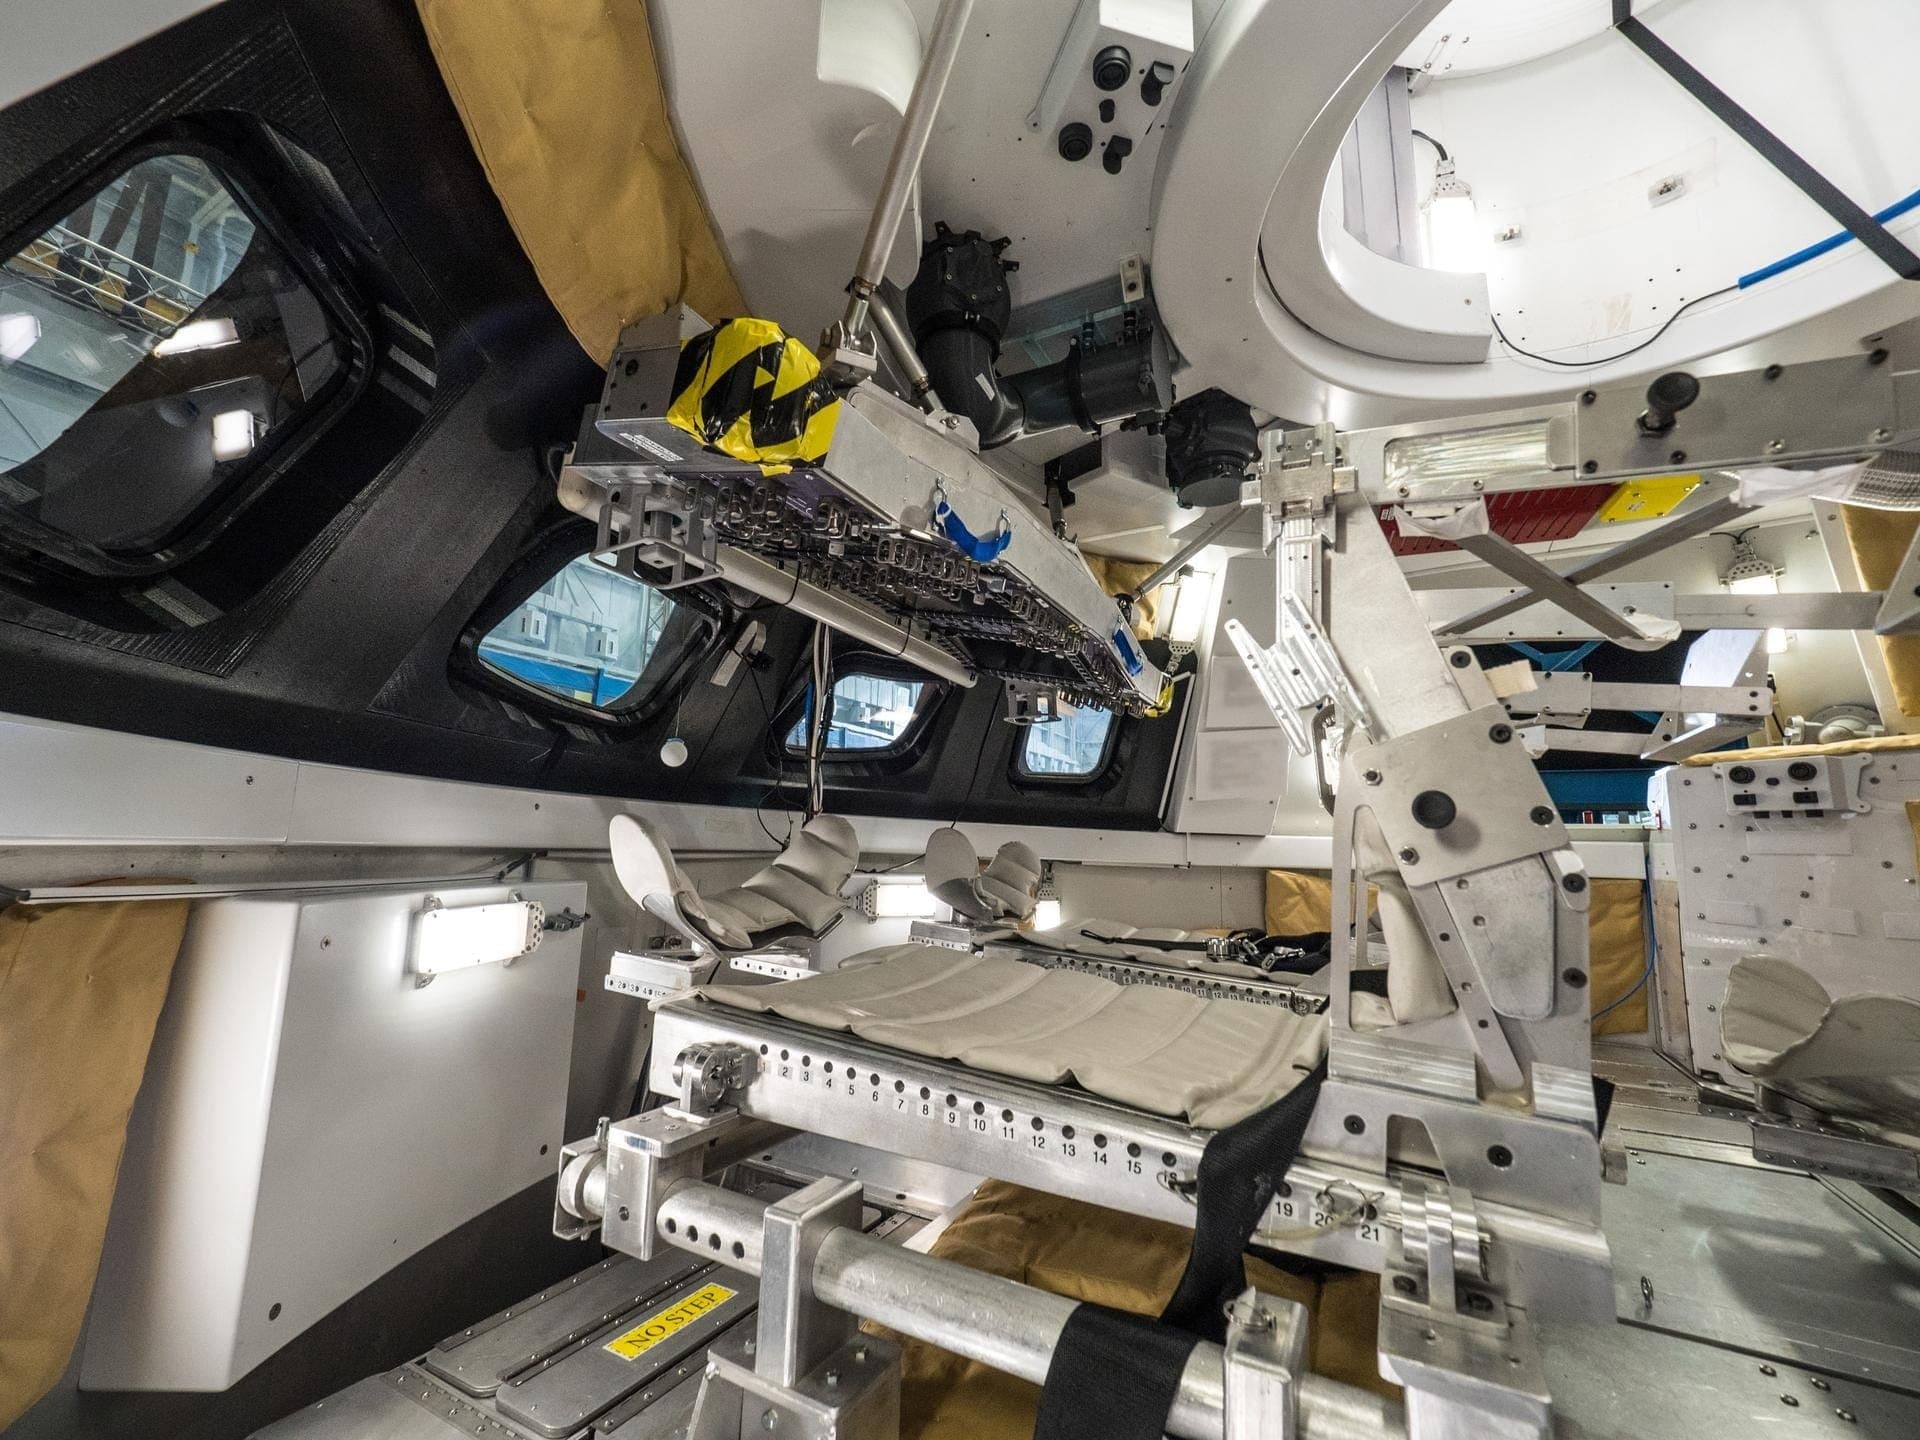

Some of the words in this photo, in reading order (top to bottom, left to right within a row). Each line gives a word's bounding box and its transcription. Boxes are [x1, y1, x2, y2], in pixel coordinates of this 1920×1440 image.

[782, 1066, 789, 1078] 2
[803, 1071, 810, 1082] 3
[826, 1078, 832, 1089] 4
[848, 1084, 855, 1096] 5
[872, 1090, 879, 1102] 6
[898, 1099, 904, 1110] 7
[922, 1103, 929, 1115] 8
[948, 1112, 956, 1124] 9
[973, 1118, 986, 1131] 10
[1002, 1126, 1015, 1139] 11
[1031, 1136, 1045, 1149] 12
[1062, 1143, 1076, 1157] 13
[1093, 1151, 1108, 1165] 14
[1127, 1159, 1142, 1175] 15
[1275, 1201, 1293, 1217] 19
[1361, 1223, 1379, 1242] 21
[626, 1324, 666, 1349] NO
[665, 1291, 719, 1326] STEP
